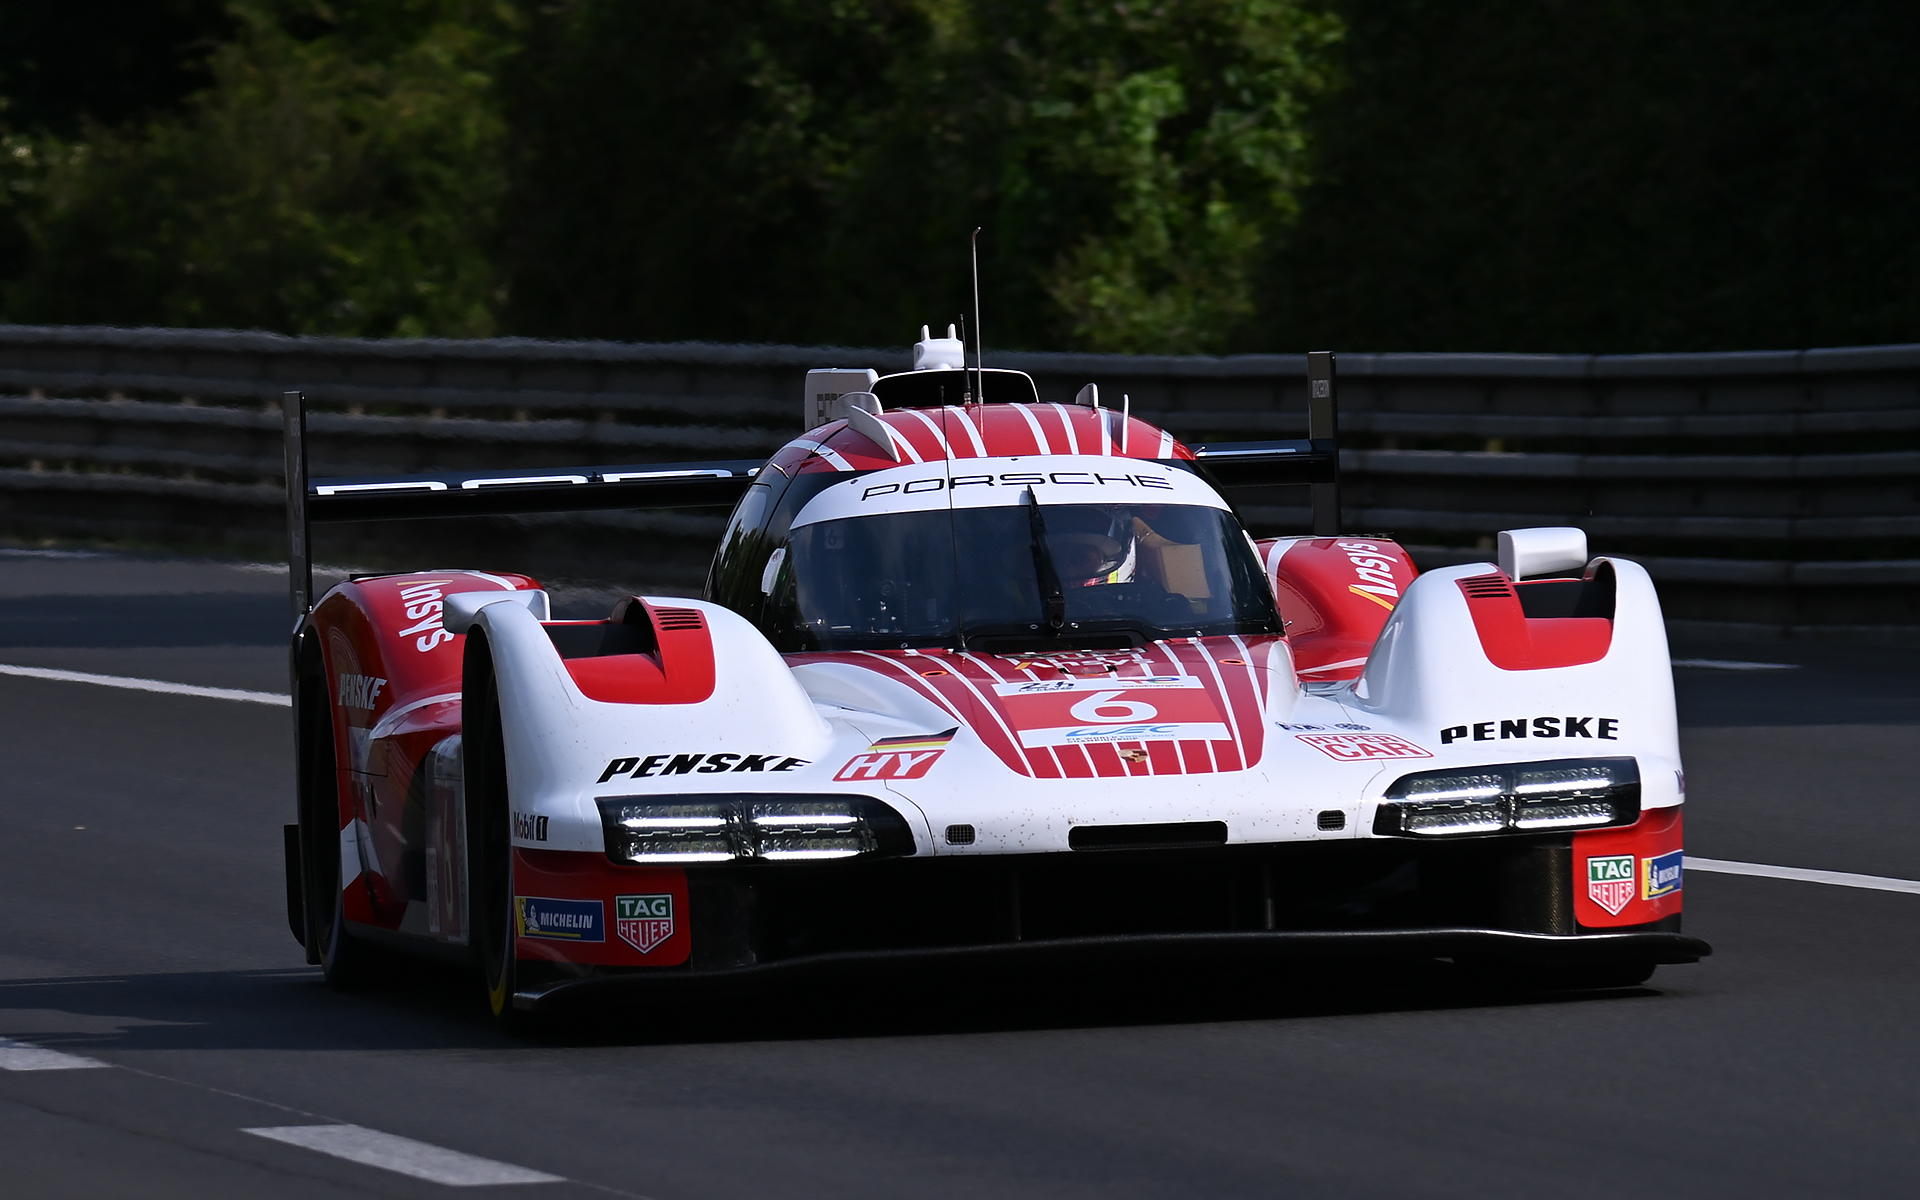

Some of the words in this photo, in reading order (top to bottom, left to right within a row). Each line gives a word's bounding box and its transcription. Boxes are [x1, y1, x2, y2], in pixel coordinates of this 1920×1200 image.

[862, 473, 1174, 501] PORSCHE
[338, 673, 388, 711] PENSKE
[1070, 691, 1157, 722] 6
[1304, 736, 1400, 745] HYPER
[1440, 717, 1619, 744] PENSKE
[1325, 743, 1424, 758] CAR
[596, 754, 813, 783] PENSKE
[840, 752, 938, 778] HY
[514, 812, 536, 840] Mobil
[1592, 860, 1631, 879] TAG
[620, 899, 667, 917] TAG
[1592, 882, 1633, 909] HEUER
[540, 912, 594, 929] MICHELIN
[621, 921, 669, 948] HEUER
